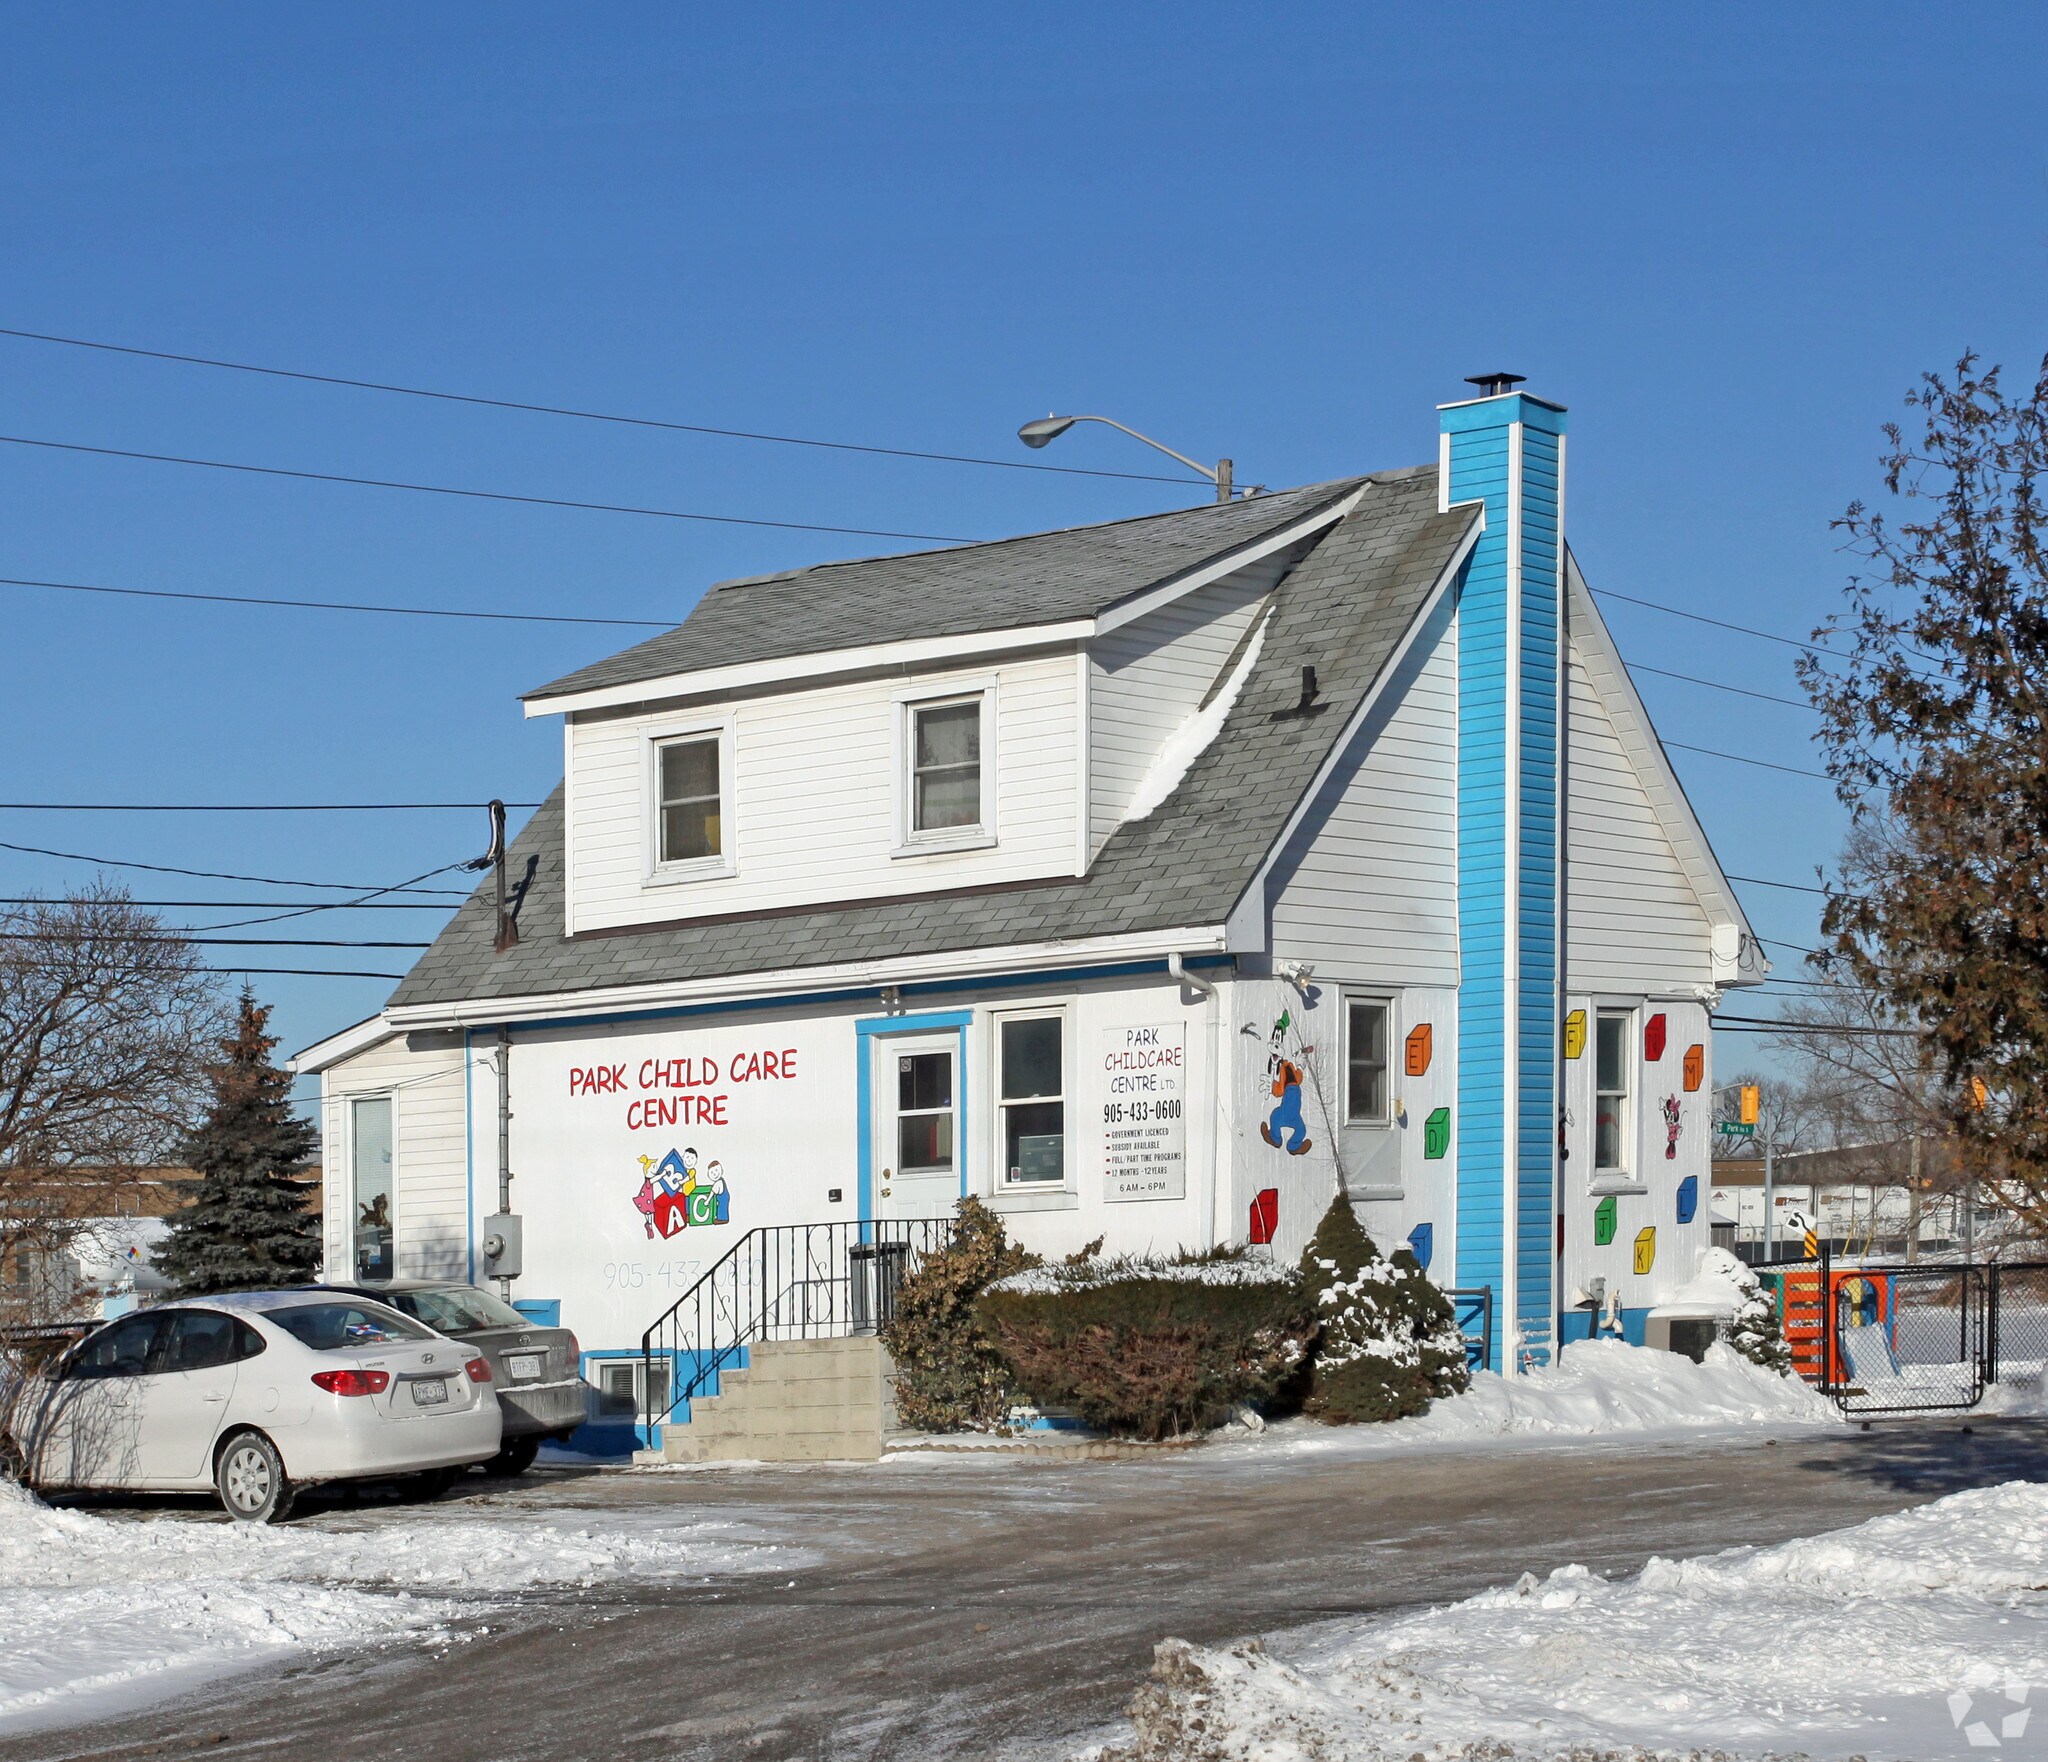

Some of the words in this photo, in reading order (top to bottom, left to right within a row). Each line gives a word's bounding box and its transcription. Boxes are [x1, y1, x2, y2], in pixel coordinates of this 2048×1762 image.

[1127, 1028, 1159, 1047] PARK
[1567, 1030, 1576, 1052] F
[1104, 1047, 1182, 1071] CHILDCARE
[1409, 1044, 1419, 1069] E
[570, 1063, 628, 1097] PARK
[638, 1056, 719, 1090] CHILD
[729, 1048, 798, 1083] CARE
[1111, 1074, 1157, 1094] CENTRE
[1685, 1064, 1696, 1087] M
[627, 1095, 729, 1131] CENTRE
[1104, 1099, 1181, 1123] 905-433-0600
[1111, 1129, 1143, 1139] GOVERNMENT
[1145, 1127, 1169, 1137] LICENCED
[1727, 1124, 1739, 1132] Park
[1111, 1142, 1132, 1152] SUBSIDY
[1134, 1140, 1160, 1150] AVAILABLE
[1428, 1129, 1437, 1153] D
[1154, 1152, 1181, 1162] PROGRAMS
[662, 1163, 684, 1191] B
[1120, 1168, 1139, 1177] MONTHS
[667, 1204, 685, 1235] A
[693, 1194, 710, 1223] C
[1598, 1217, 1608, 1238] J
[1636, 1246, 1644, 1270] K
